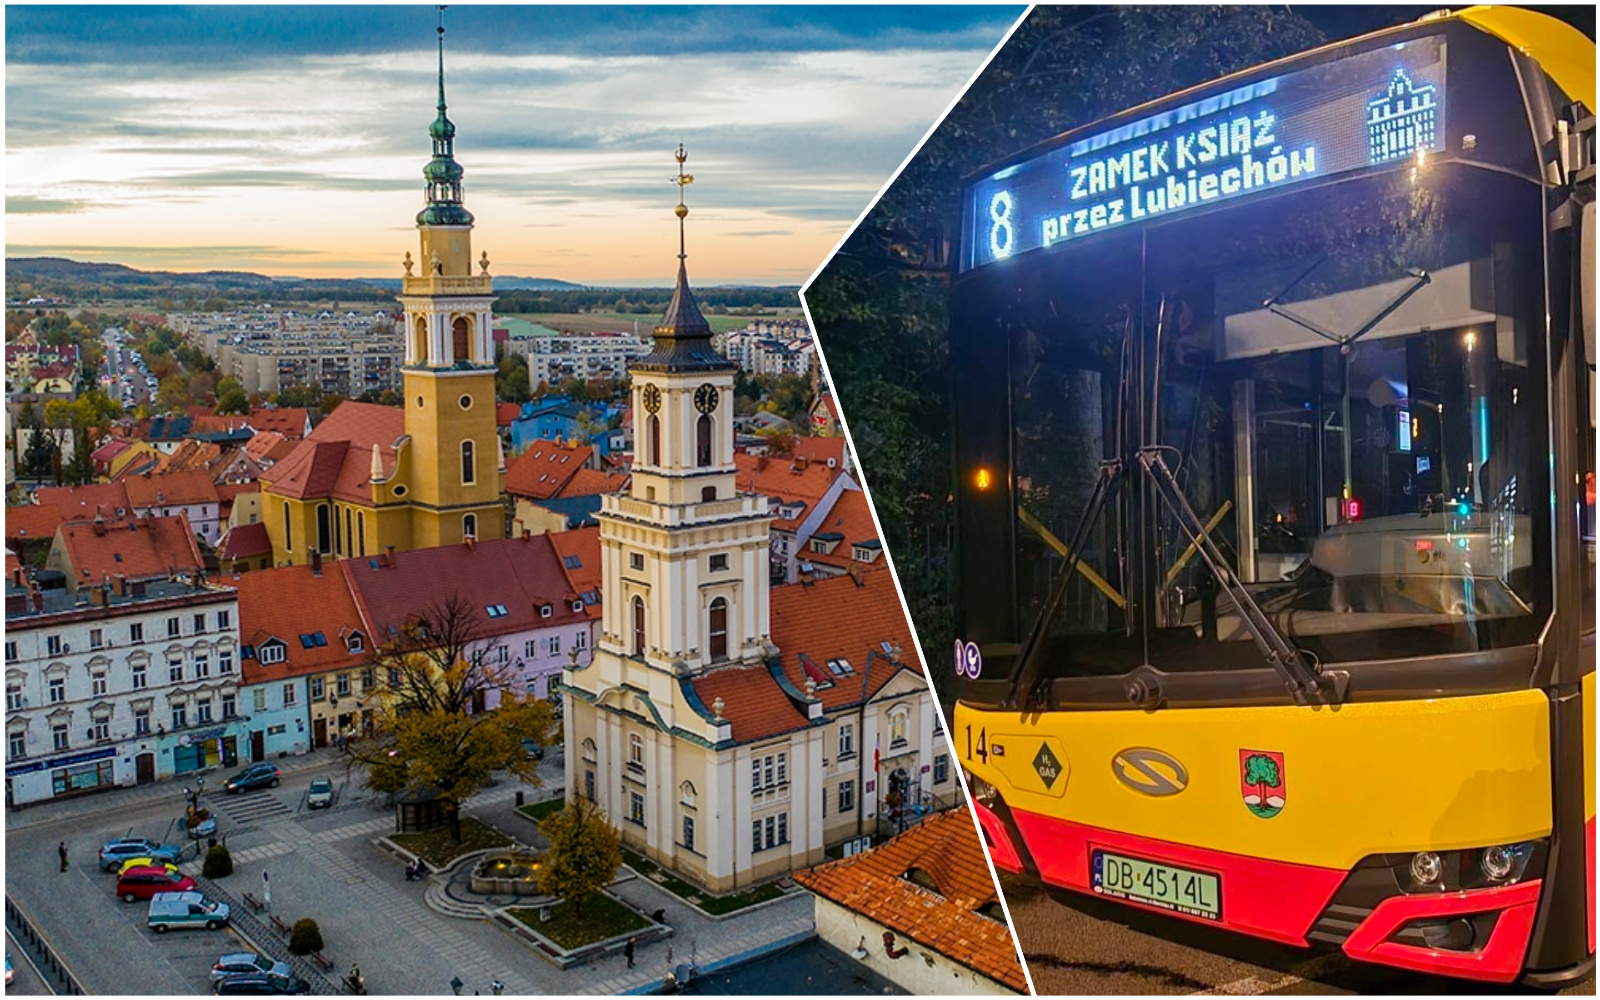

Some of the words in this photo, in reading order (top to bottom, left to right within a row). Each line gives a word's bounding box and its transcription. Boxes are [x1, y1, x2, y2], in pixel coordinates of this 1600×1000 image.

[1070, 140, 1169, 200] ZAMEK
[1041, 198, 1125, 248] przez
[1130, 145, 1316, 219] Lubiechów
[989, 189, 1014, 259] 8
[965, 724, 988, 765] 14
[1039, 766, 1056, 778] GAS
[1094, 873, 1103, 883] PL
[1107, 859, 1134, 890] DB
[1143, 867, 1211, 907] 4514L
